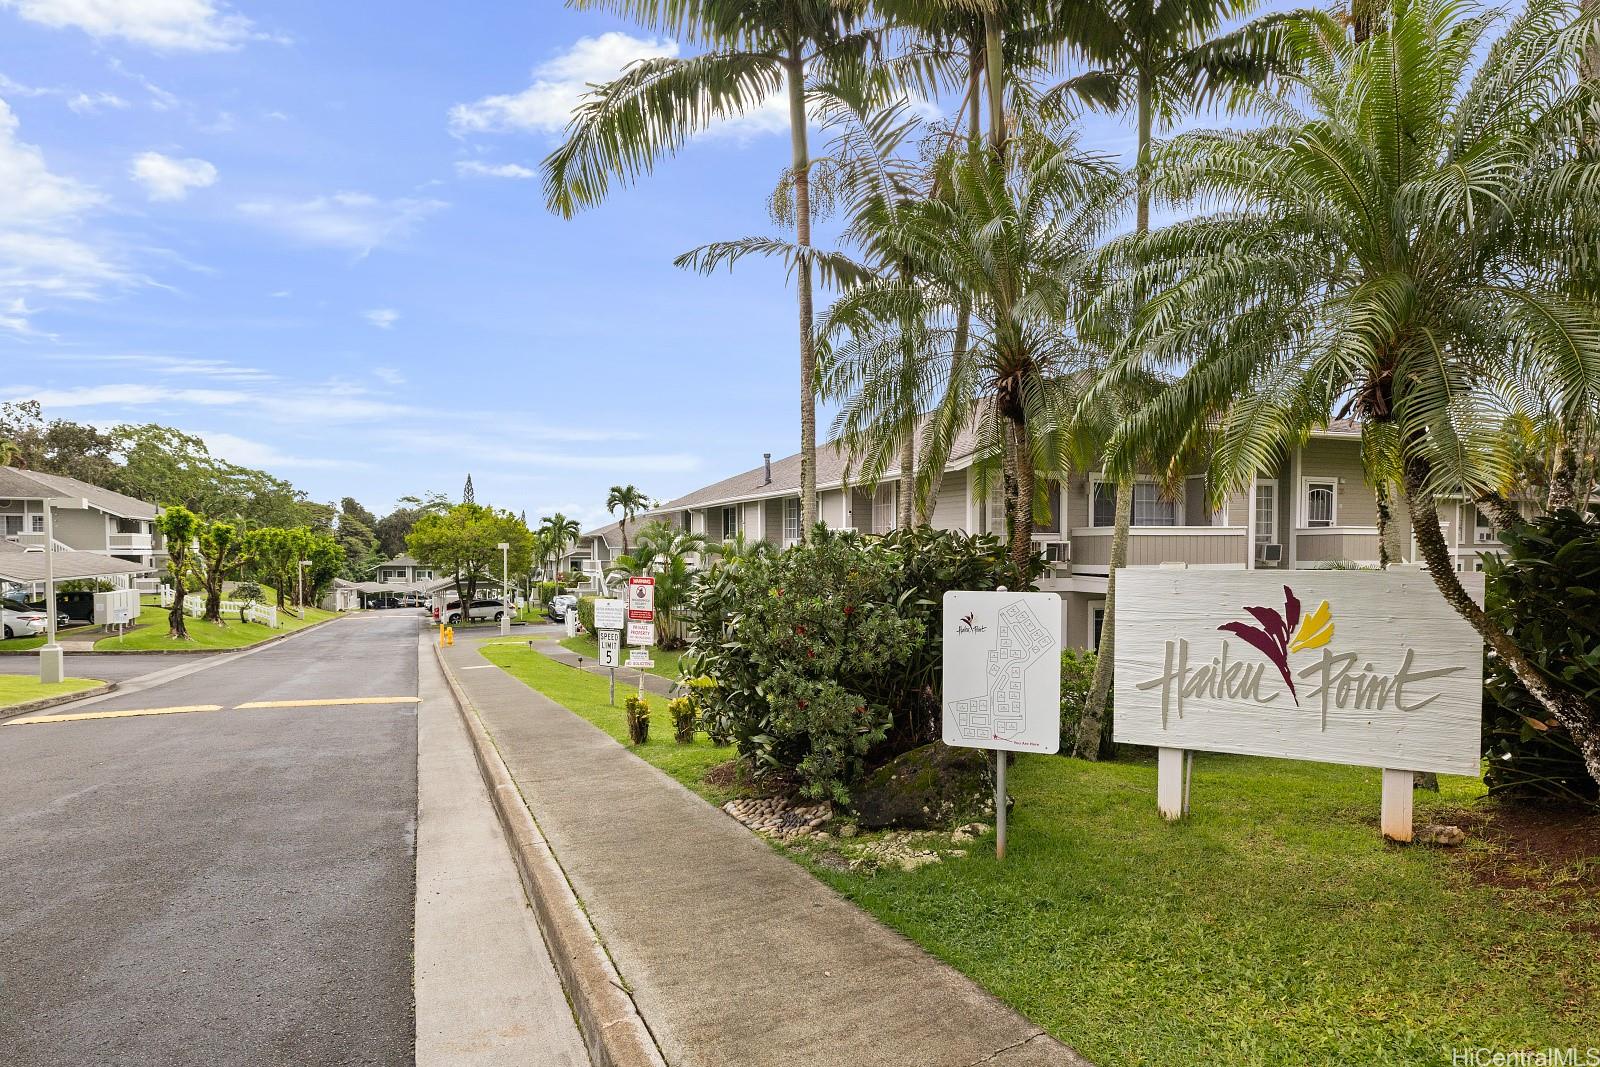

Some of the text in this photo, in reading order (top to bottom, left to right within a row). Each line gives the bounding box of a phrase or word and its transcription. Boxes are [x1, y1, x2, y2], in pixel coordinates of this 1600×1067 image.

[601, 642, 617, 650] LIMIT
[606, 651, 612, 664] 5
[1136, 638, 1466, 733] Haiku Point
